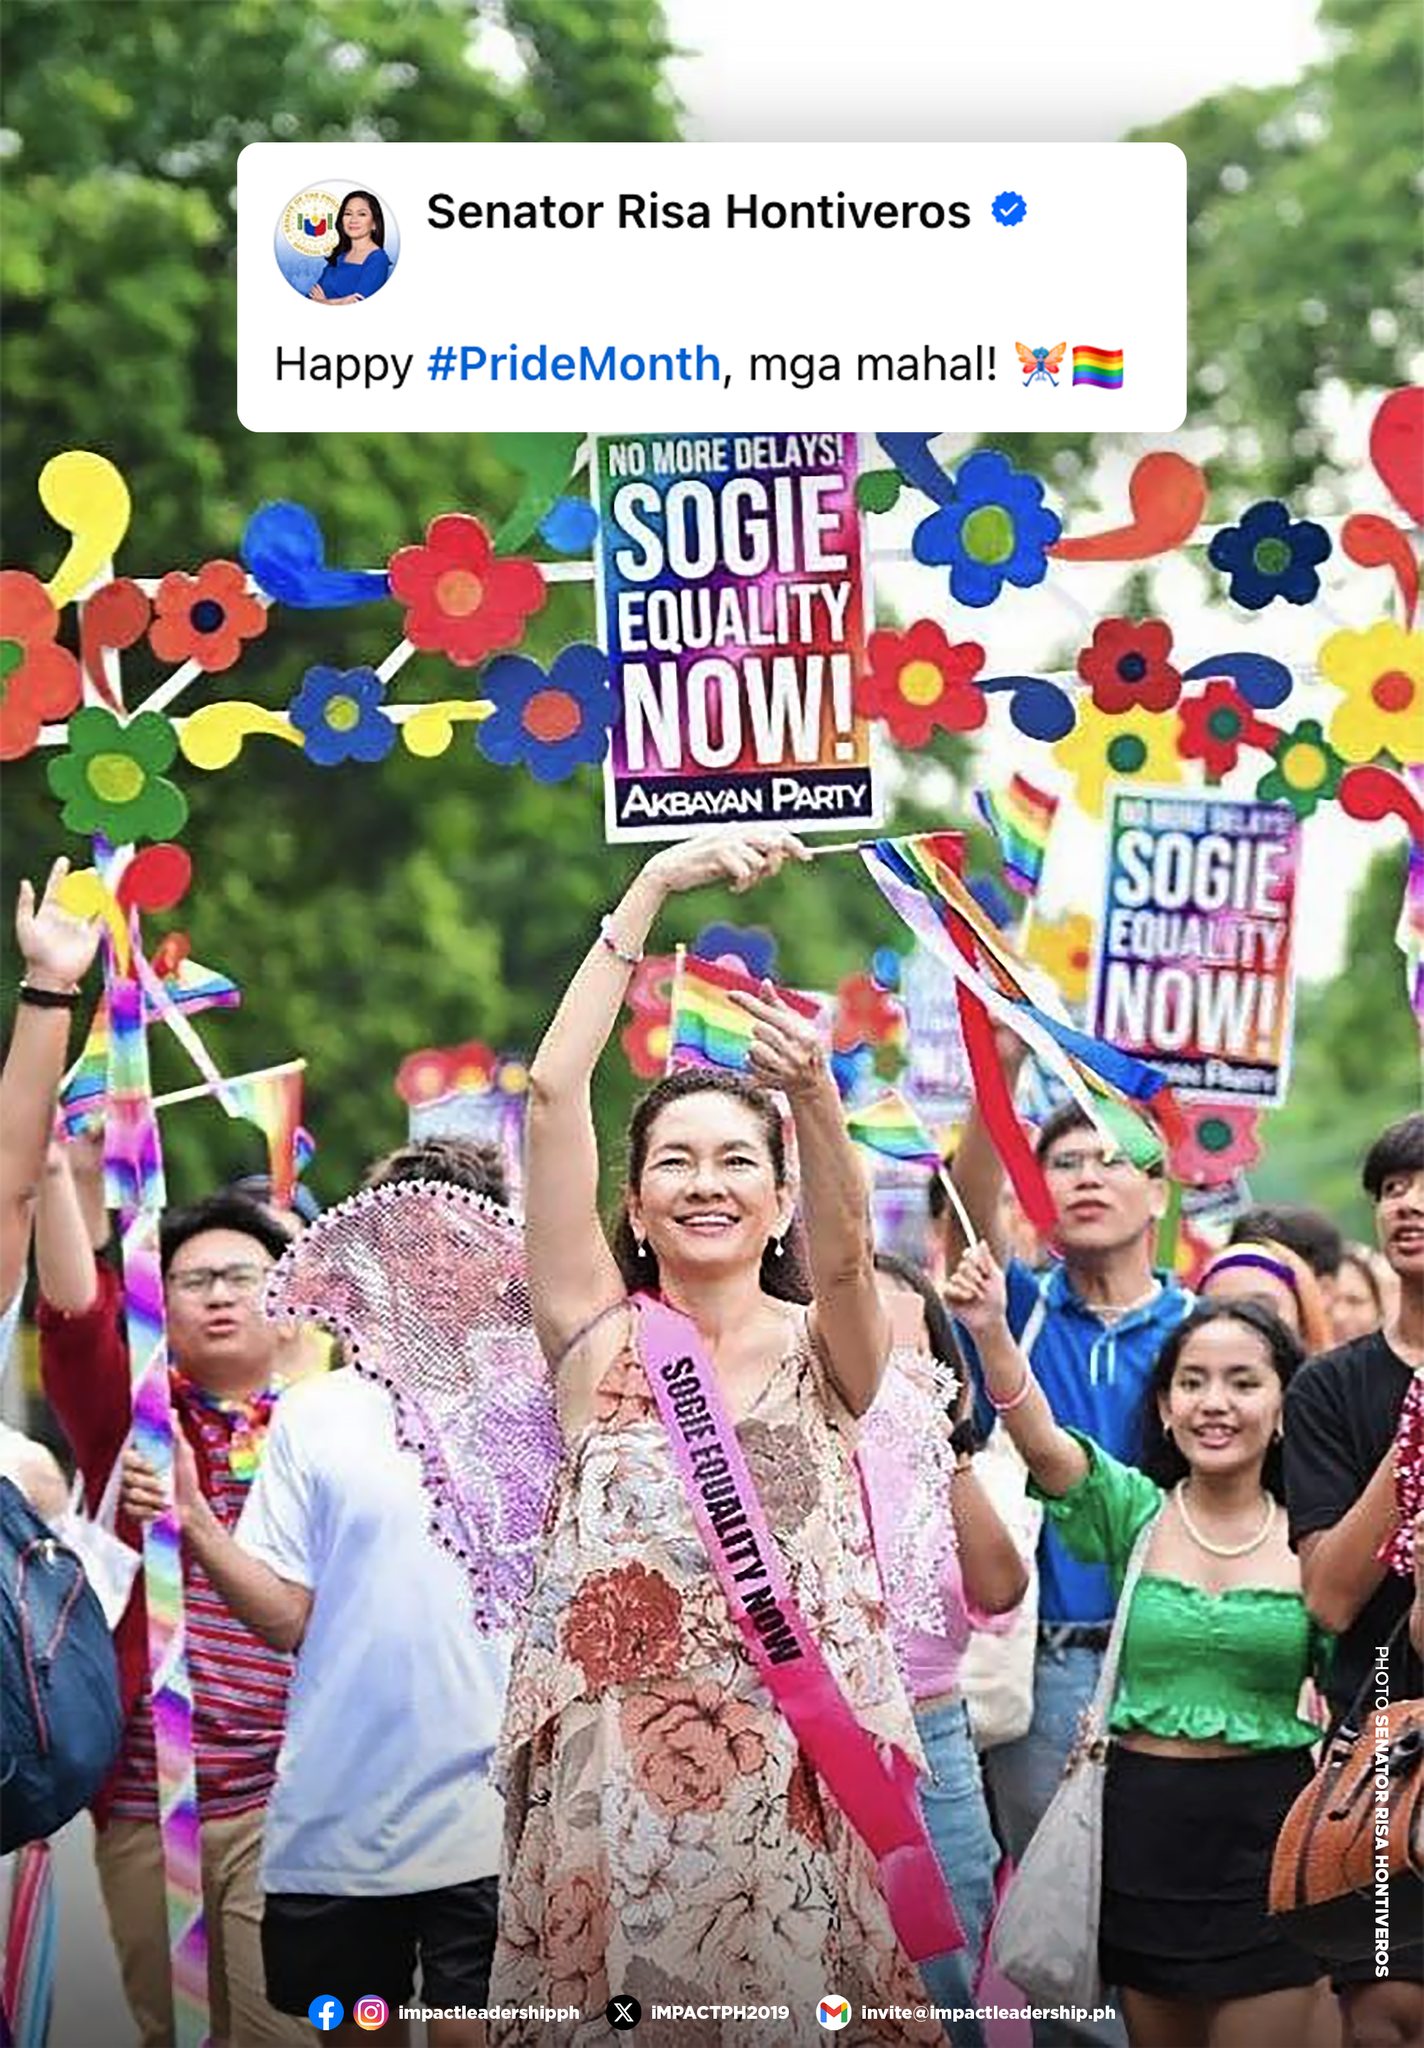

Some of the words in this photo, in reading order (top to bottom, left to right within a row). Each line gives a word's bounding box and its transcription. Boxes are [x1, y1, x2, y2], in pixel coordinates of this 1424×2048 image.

[608, 441, 646, 477] NO
[653, 436, 728, 475] MORE
[735, 433, 845, 469] DELAYS!
[612, 474, 848, 583] SOGIE
[617, 581, 852, 654] EQUALITY
[621, 654, 856, 772] NOW!
[1113, 829, 1287, 916] SOGIE
[1109, 908, 1287, 971] EQUALITY
[1104, 959, 1278, 1058] NOW!
[659, 1355, 717, 1444] SOGIE
[689, 1442, 768, 1584] EQUALITY
[741, 1584, 804, 1666] NOW
